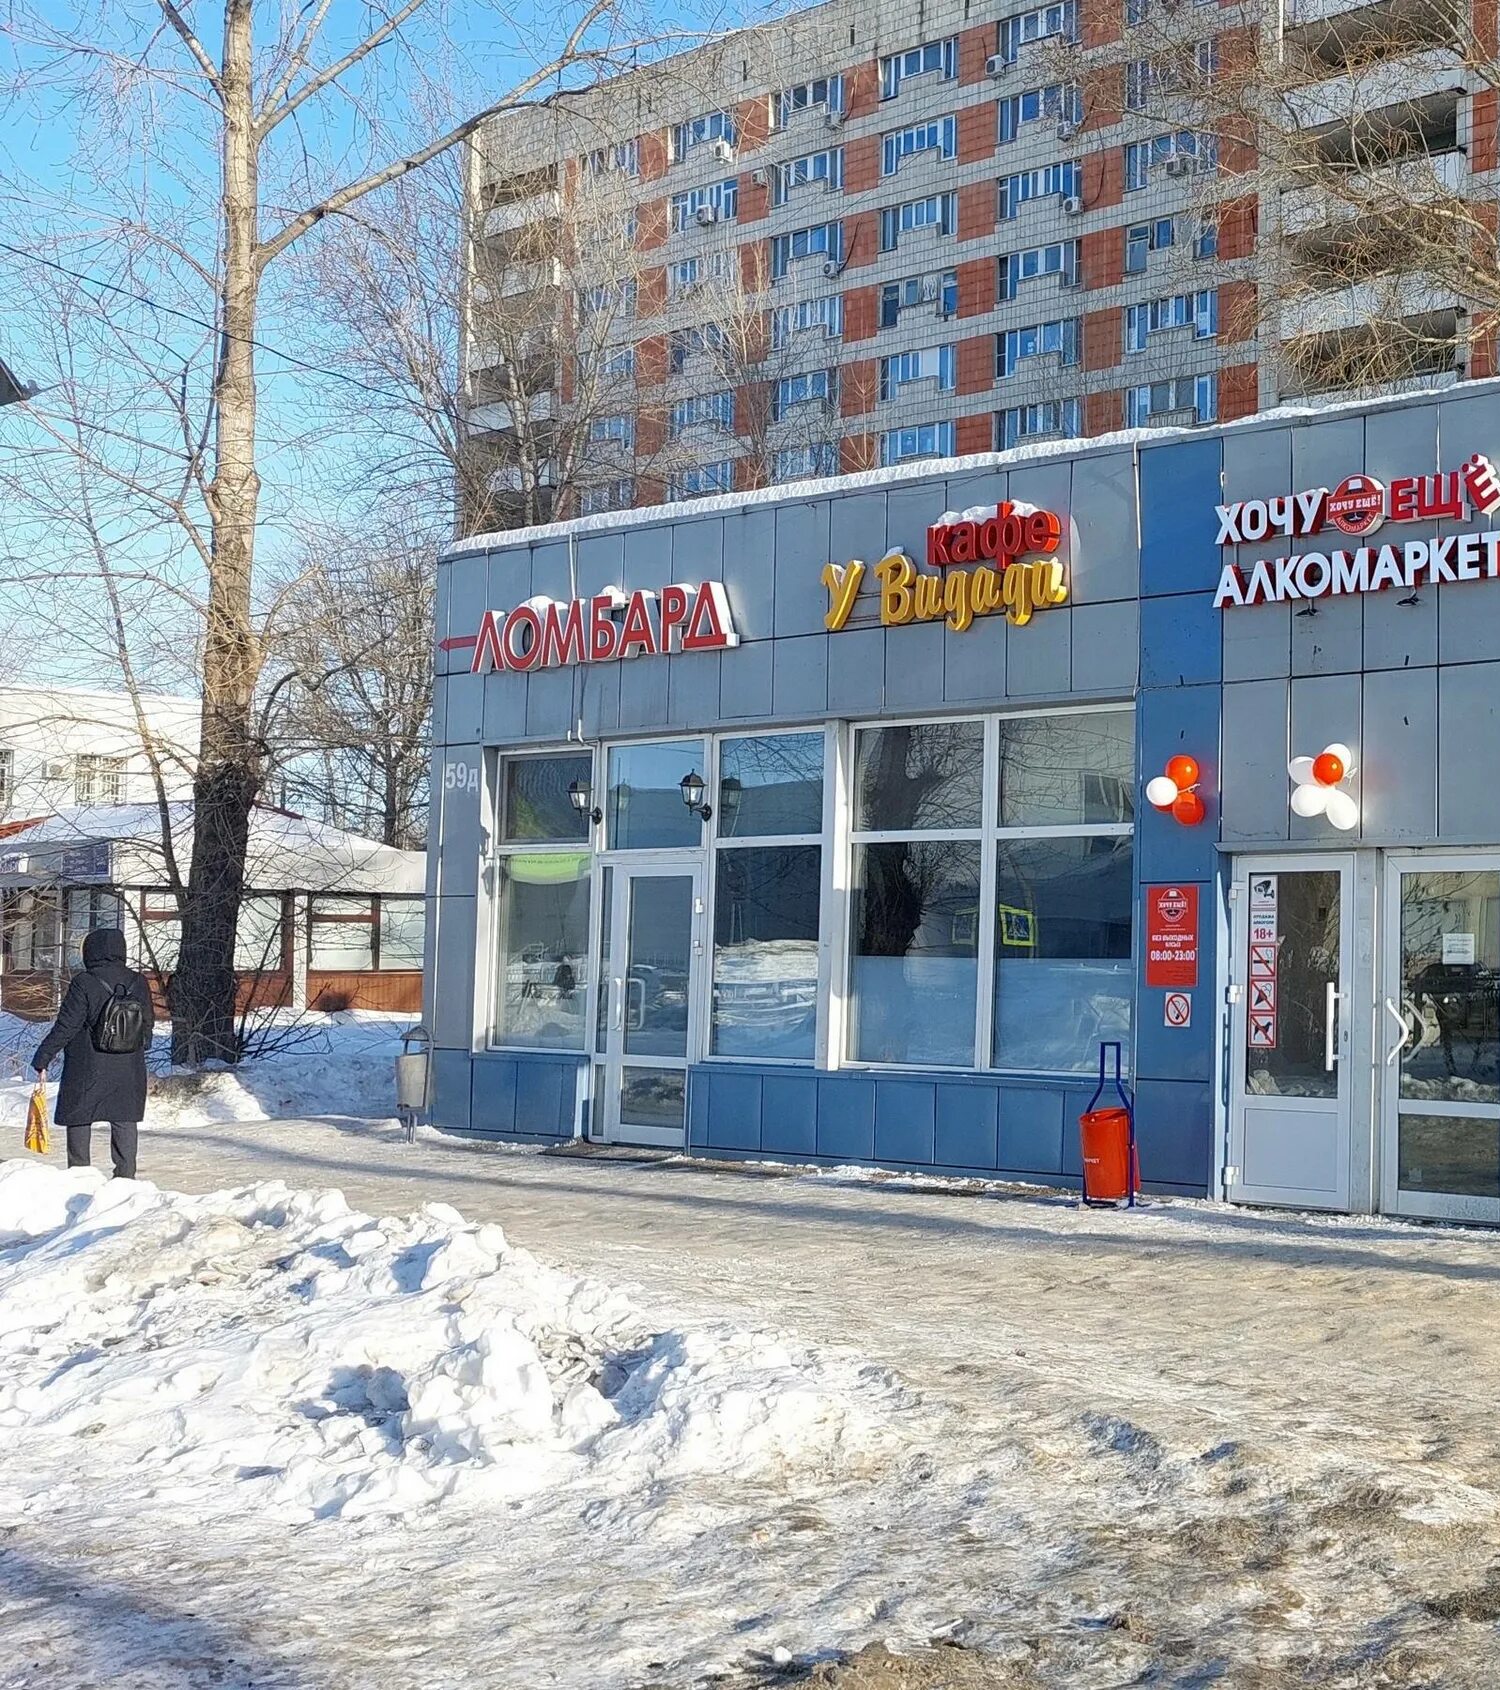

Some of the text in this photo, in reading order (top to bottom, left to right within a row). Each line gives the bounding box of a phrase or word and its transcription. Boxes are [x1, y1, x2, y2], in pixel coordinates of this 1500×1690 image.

[928, 501, 1062, 570] кафе
[1214, 490, 1329, 545] ХОЧУ
[821, 554, 1068, 632] У Видади
[471, 581, 740, 674] ЛОМБАРД
[1150, 949, 1196, 961] 08:00-23:00
[1253, 928, 1274, 940] 18+
